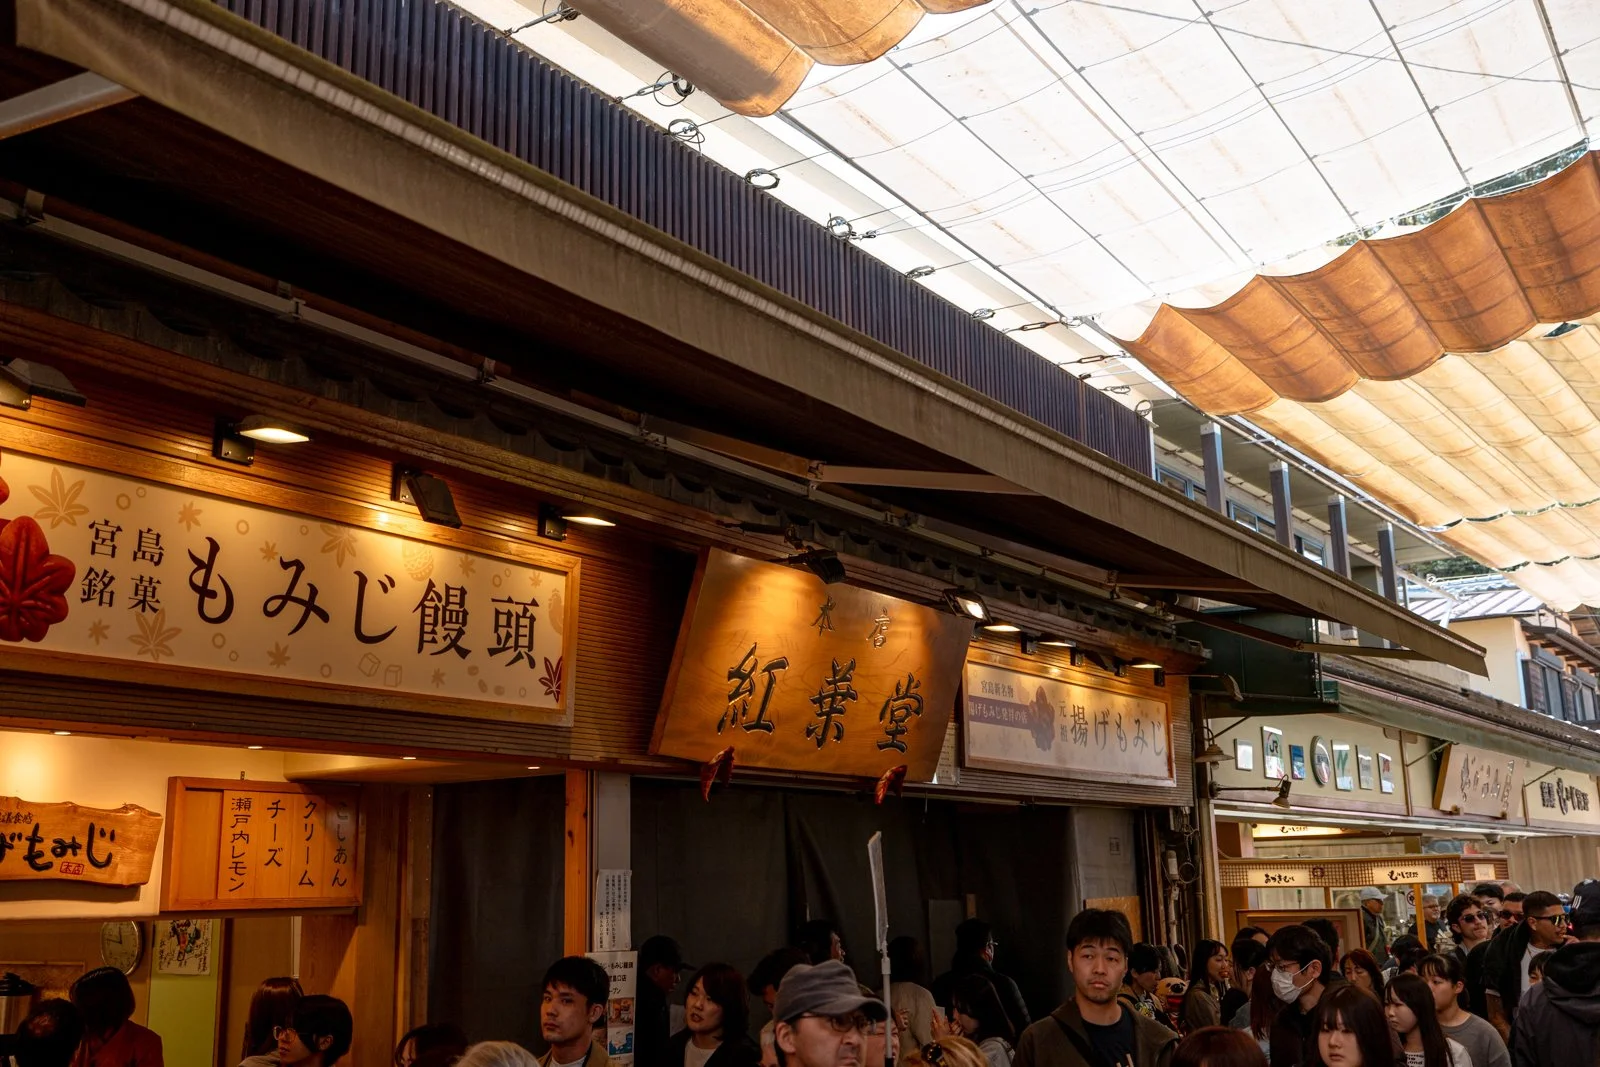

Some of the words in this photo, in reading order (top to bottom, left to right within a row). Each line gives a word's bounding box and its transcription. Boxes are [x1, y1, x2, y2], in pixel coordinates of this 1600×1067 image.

[187, 536, 539, 670] もみじ饅頭
[716, 641, 924, 754] 紅葉堂
[1069, 703, 1165, 757] 揚げもみじ
[1269, 739, 1279, 754] JR
[228, 797, 253, 893] 瀬戸内レモン
[263, 798, 287, 868] チーズ
[297, 799, 318, 887] クリーム
[331, 801, 349, 888] こしあん
